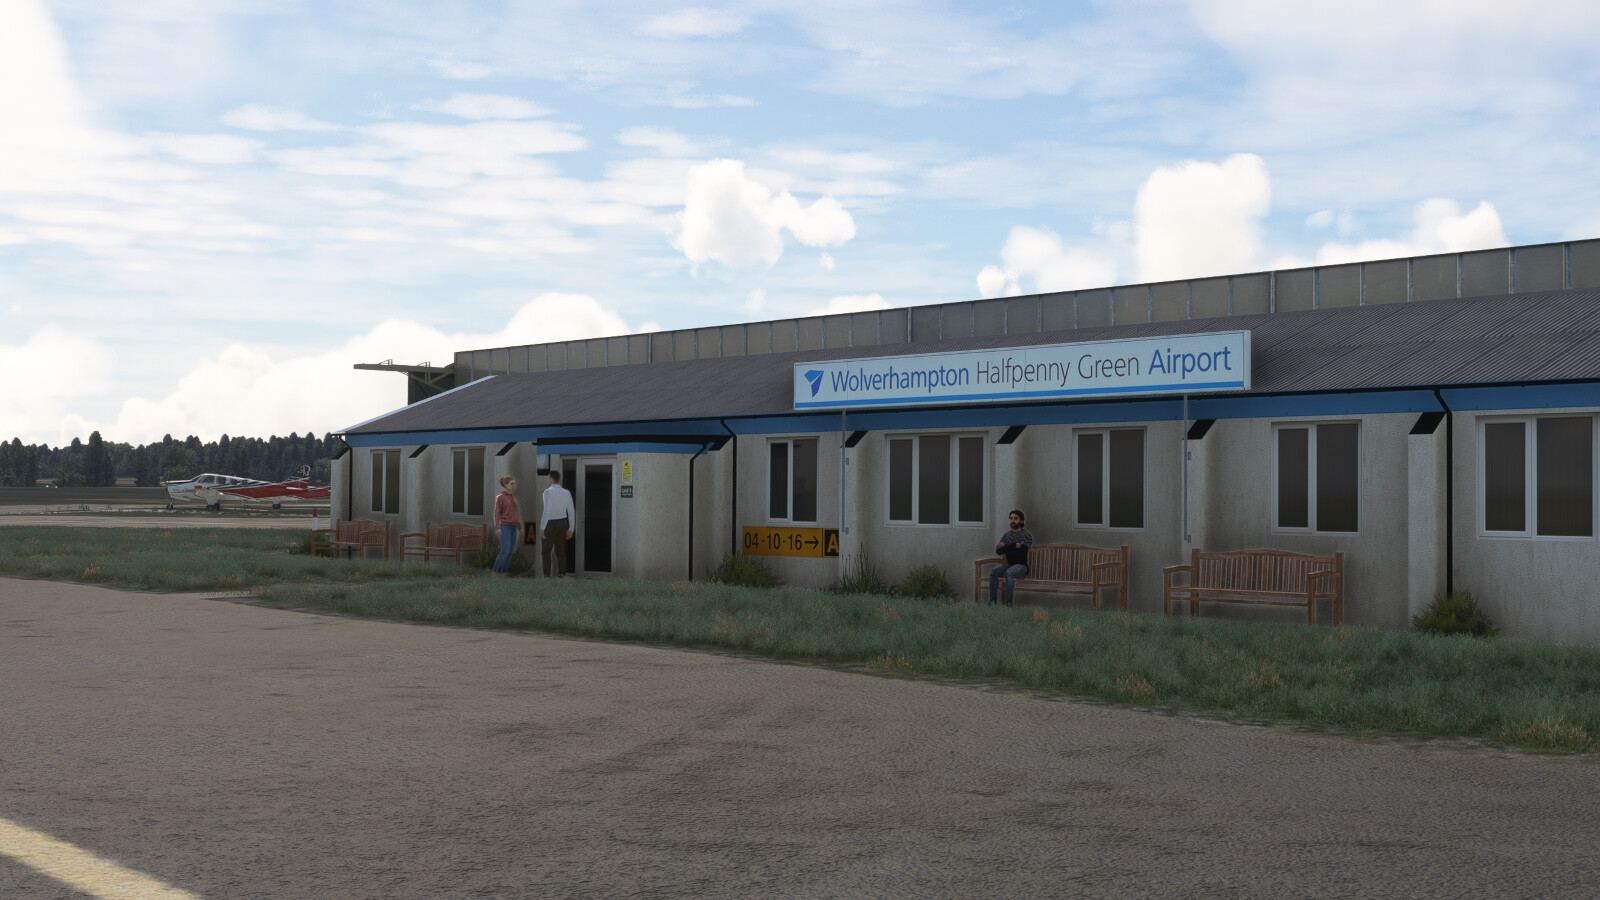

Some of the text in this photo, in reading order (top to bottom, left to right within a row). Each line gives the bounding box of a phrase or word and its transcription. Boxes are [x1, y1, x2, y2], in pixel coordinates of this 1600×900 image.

[831, 346, 1231, 393] Wolverhampton Halfpenny Green Airport
[527, 525, 536, 542] A
[827, 533, 839, 553] A
